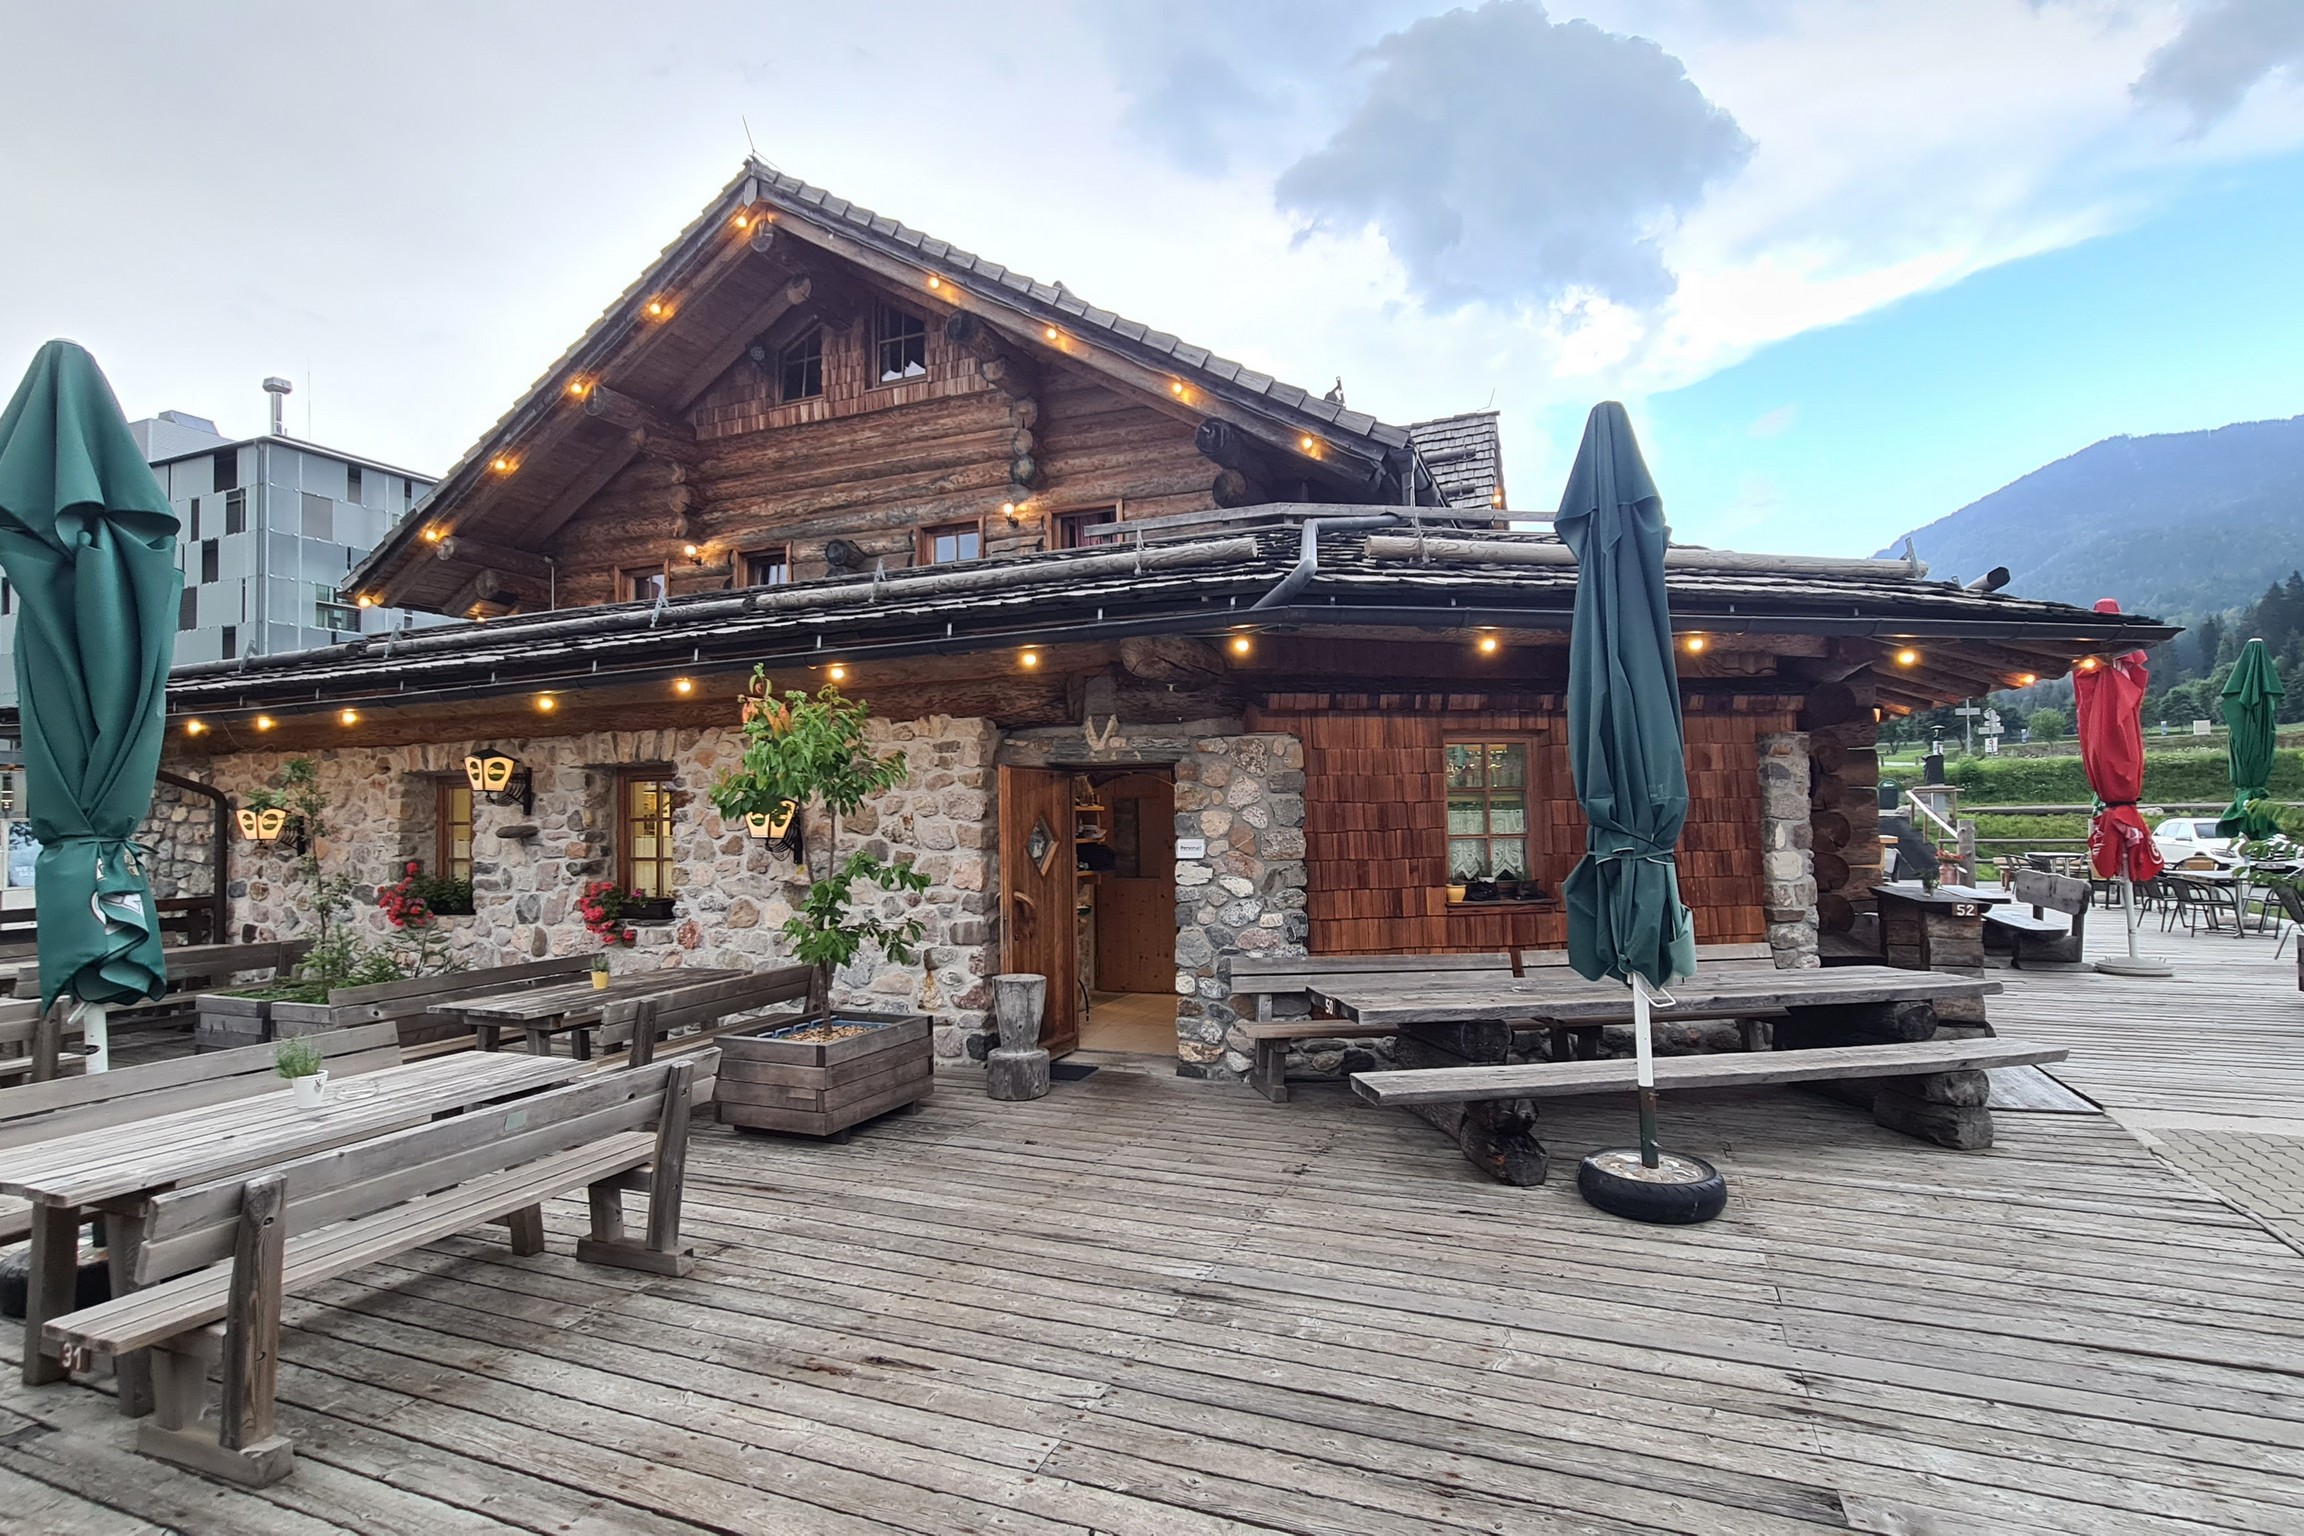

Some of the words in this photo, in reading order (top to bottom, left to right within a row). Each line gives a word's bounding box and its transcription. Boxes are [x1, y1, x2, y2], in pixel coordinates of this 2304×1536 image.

[1956, 904, 1975, 916] 52
[1325, 998, 1334, 1015] 50
[62, 1342, 82, 1370] 31
